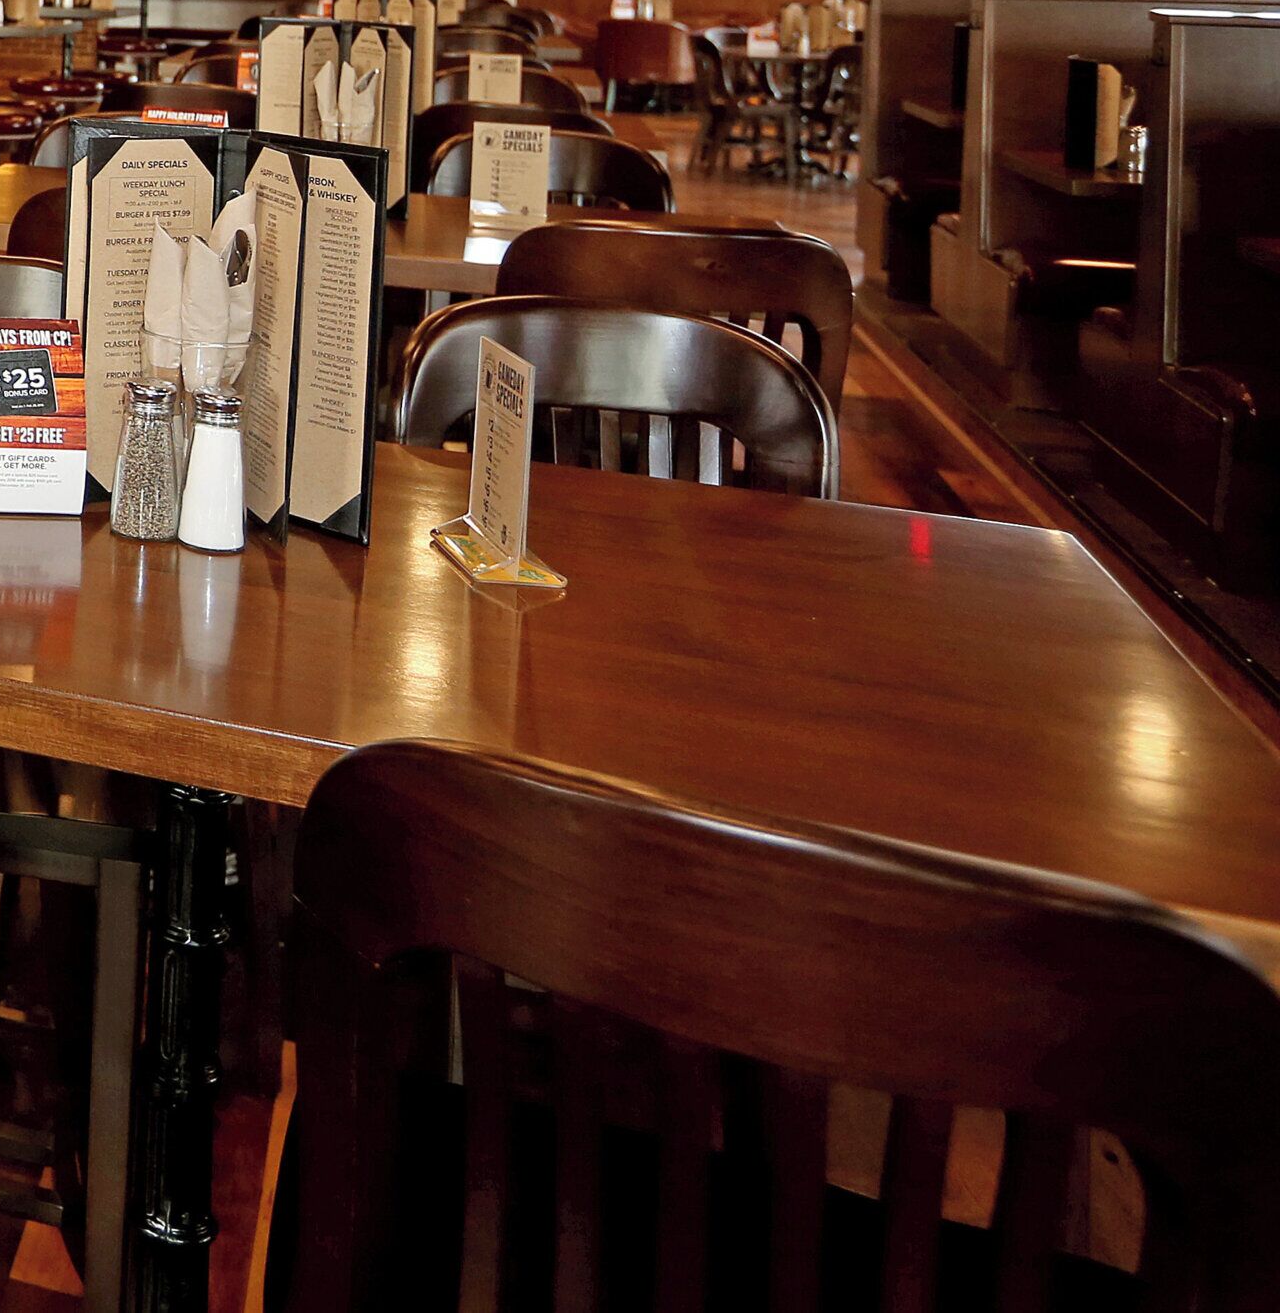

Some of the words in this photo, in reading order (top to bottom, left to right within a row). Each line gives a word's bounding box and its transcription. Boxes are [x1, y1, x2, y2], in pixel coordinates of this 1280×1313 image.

[147, 110, 167, 118] HAPPY
[167, 111, 195, 121] HOLIDAYS
[196, 112, 213, 122] FROM
[503, 130, 543, 141] GAMEDAY
[503, 141, 543, 153] SPECIALS
[122, 161, 145, 169] DAILY
[148, 160, 188, 168] SPECIALS
[309, 176, 336, 188] RBON,
[317, 190, 358, 204] WHISKEY
[152, 210, 171, 218] FRIES
[325, 207, 343, 215] SINGLE
[331, 215, 352, 223] SCOTCH
[106, 238, 135, 246] BURGER
[20, 329, 52, 346] FROM
[54, 330, 72, 347] CP!
[312, 350, 335, 360] BLENDED
[336, 354, 358, 365] SCOTCH
[2, 367, 45, 389] $25
[498, 361, 524, 395] GAMEDAY
[4, 390, 28, 398] BONUS
[29, 388, 48, 396] CARD
[321, 397, 345, 407] WHISKEY
[496, 382, 523, 419] SPECIALS
[15, 427, 34, 443] $25
[27, 455, 57, 463] CARDS.
